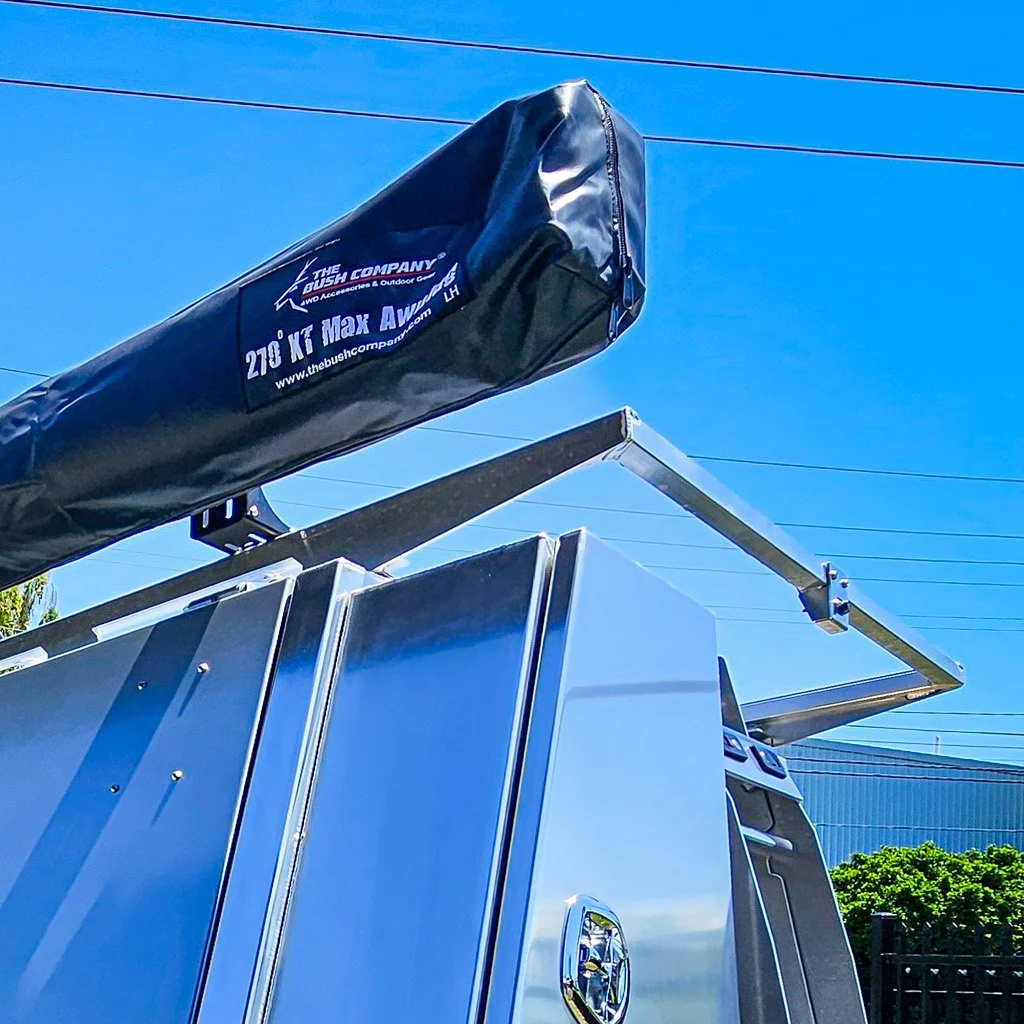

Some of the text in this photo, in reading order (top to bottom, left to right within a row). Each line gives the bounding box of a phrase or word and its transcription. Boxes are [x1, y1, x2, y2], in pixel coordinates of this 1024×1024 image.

[312, 263, 341, 280] THE
[302, 274, 348, 294] BUSH
[320, 281, 371, 300] Accessories
[380, 276, 415, 287] Outdoor
[443, 284, 461, 303] LH
[321, 312, 370, 347] Max
[275, 307, 432, 389] www.thebushcompany.com
